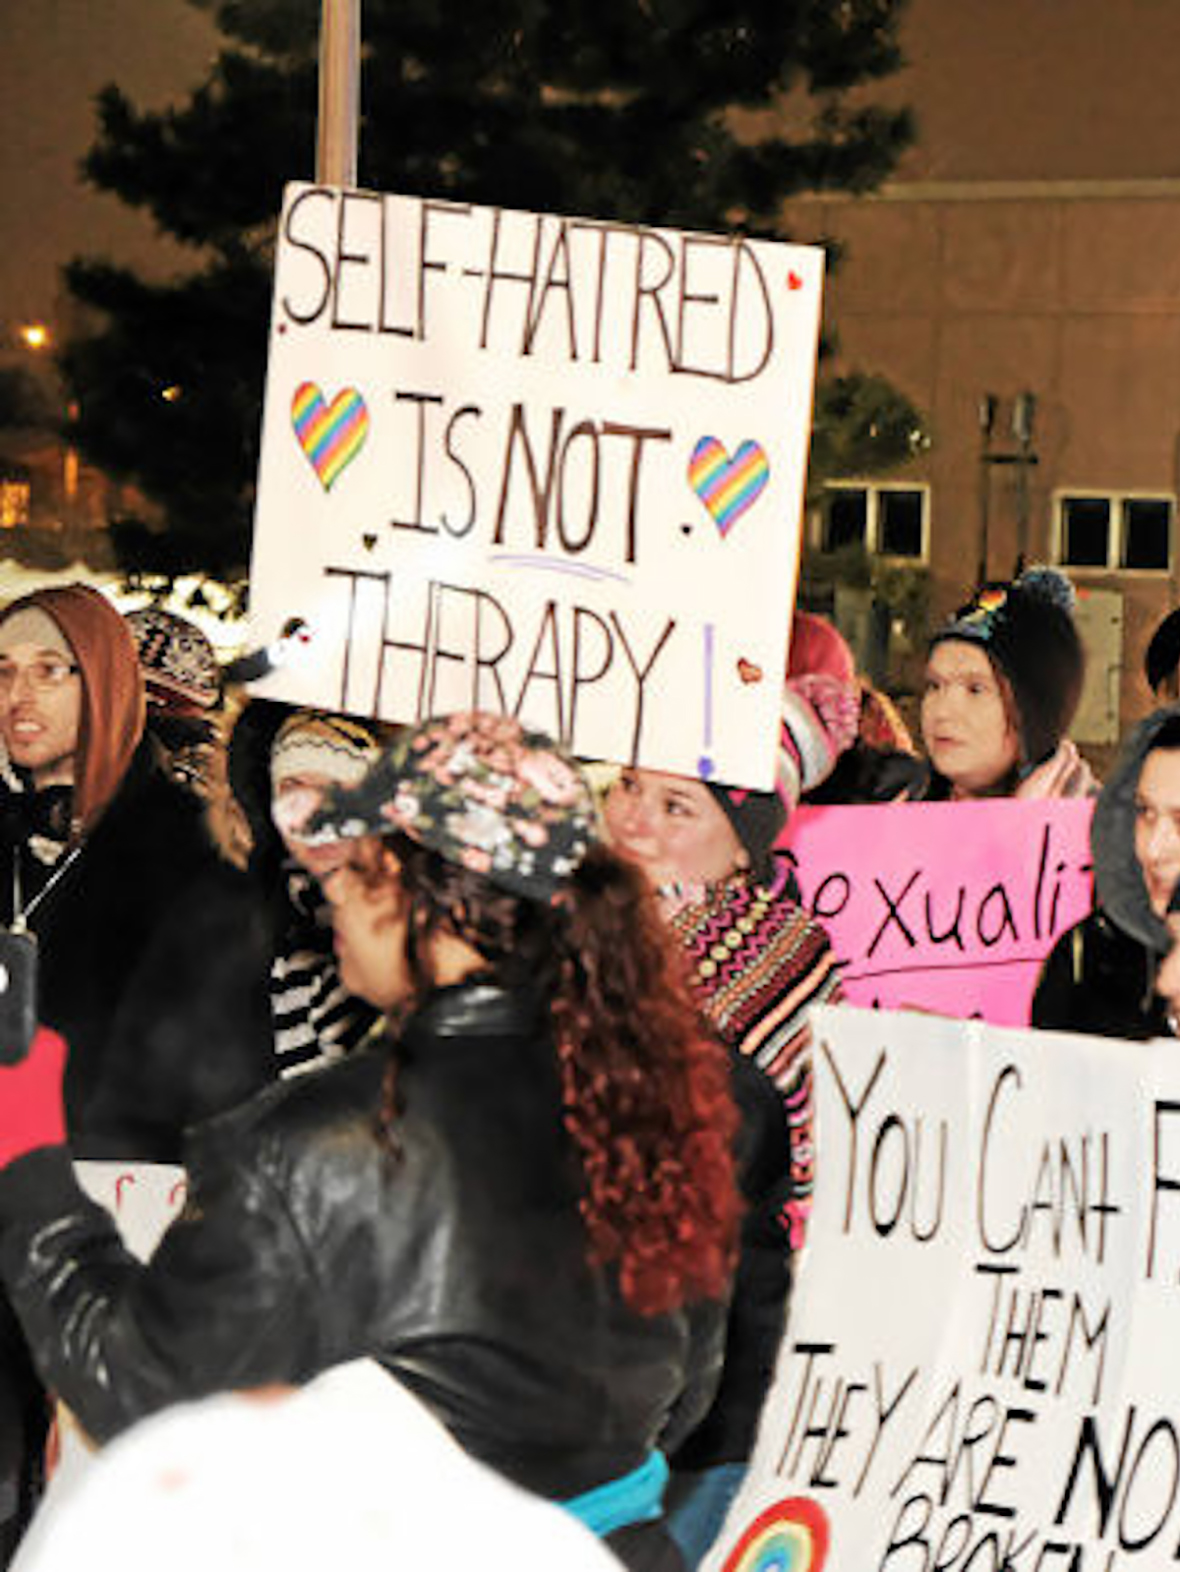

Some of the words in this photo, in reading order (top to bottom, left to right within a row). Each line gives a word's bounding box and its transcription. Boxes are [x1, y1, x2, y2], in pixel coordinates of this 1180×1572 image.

[283, 188, 774, 384] SELF-HATRED
[391, 391, 483, 538] IS
[492, 403, 673, 563] NOT
[774, 822, 1093, 966] exuali
[820, 1040, 949, 1242] YOU
[975, 1262, 1112, 1406] THEM
[775, 1342, 919, 1499] THEY
[888, 1380, 1036, 1518] ARE
